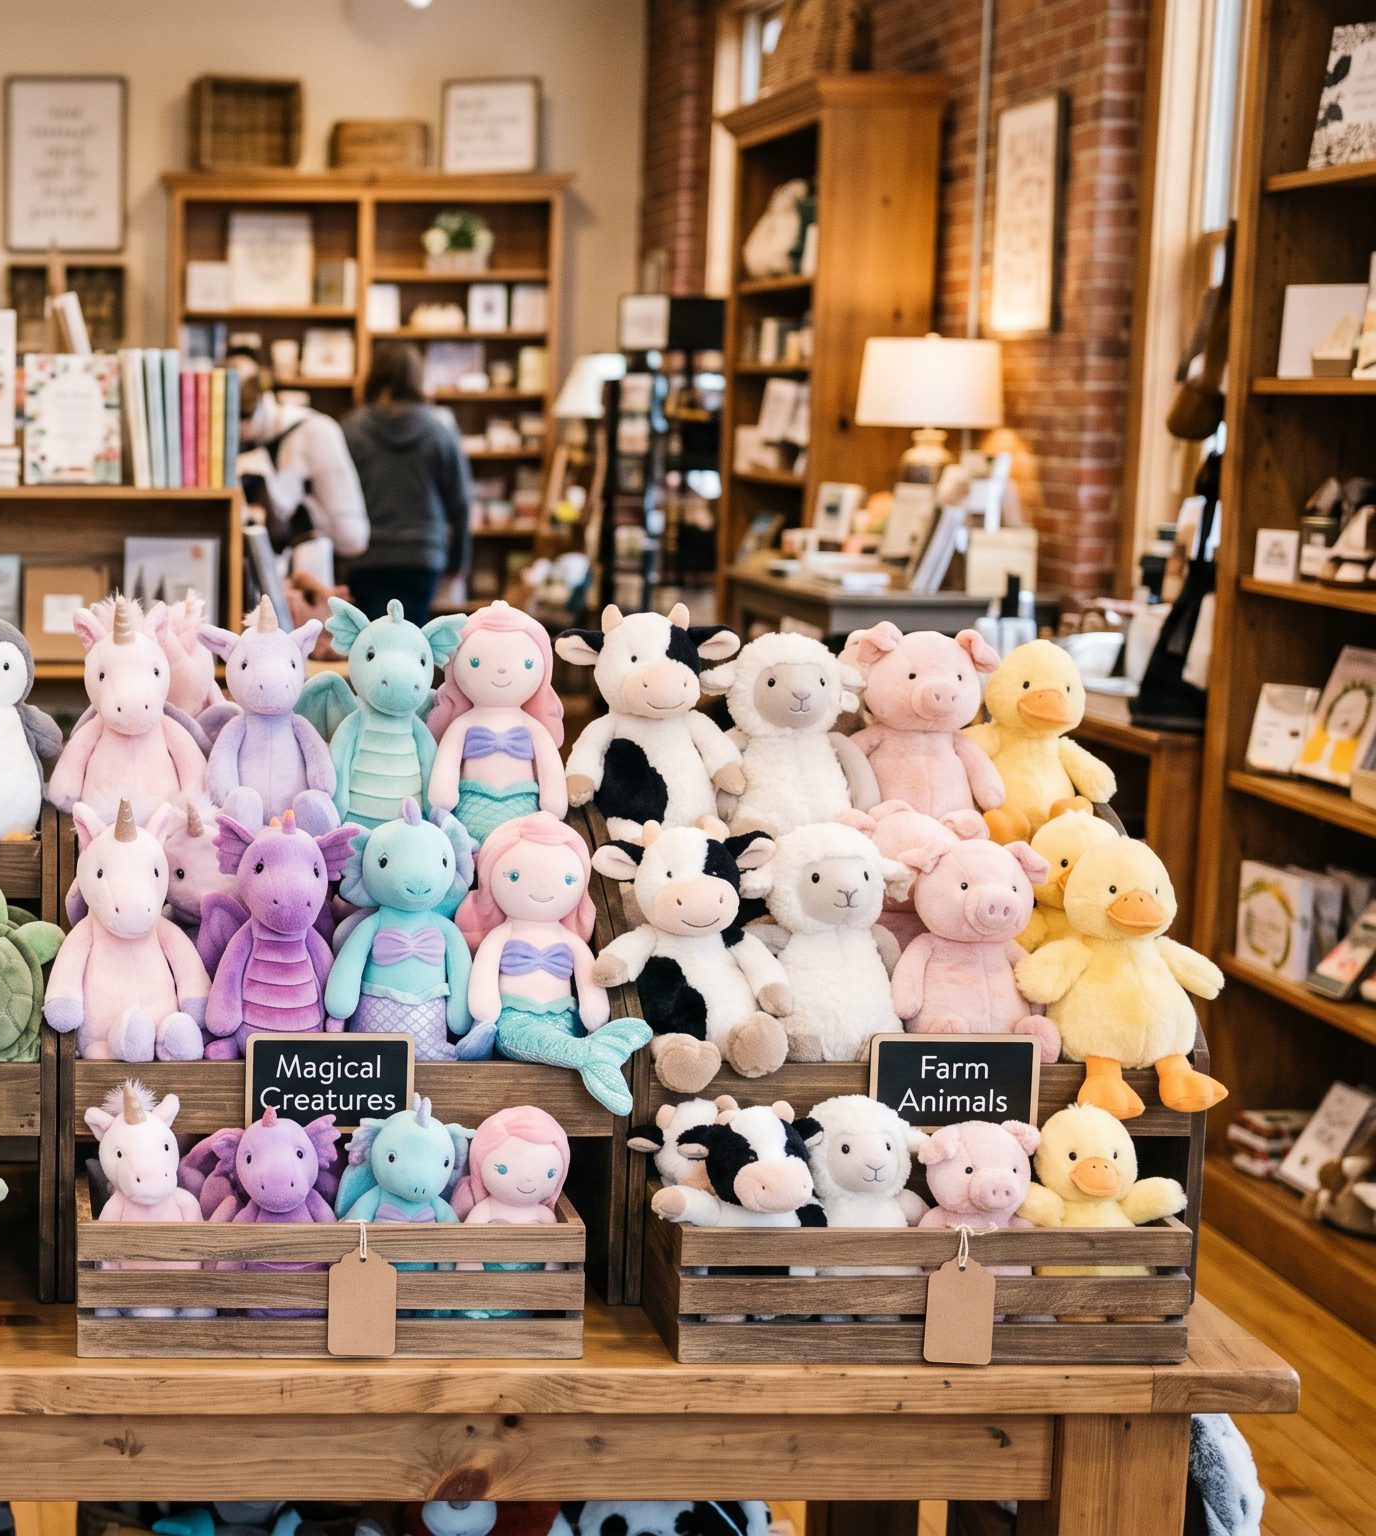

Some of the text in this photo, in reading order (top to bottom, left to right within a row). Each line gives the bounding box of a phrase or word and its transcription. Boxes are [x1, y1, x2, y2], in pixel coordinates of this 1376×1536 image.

[275, 1054, 381, 1085] Magical
[921, 1055, 989, 1080] Farm
[259, 1086, 396, 1111] Creatures
[897, 1087, 1008, 1112] Animals
